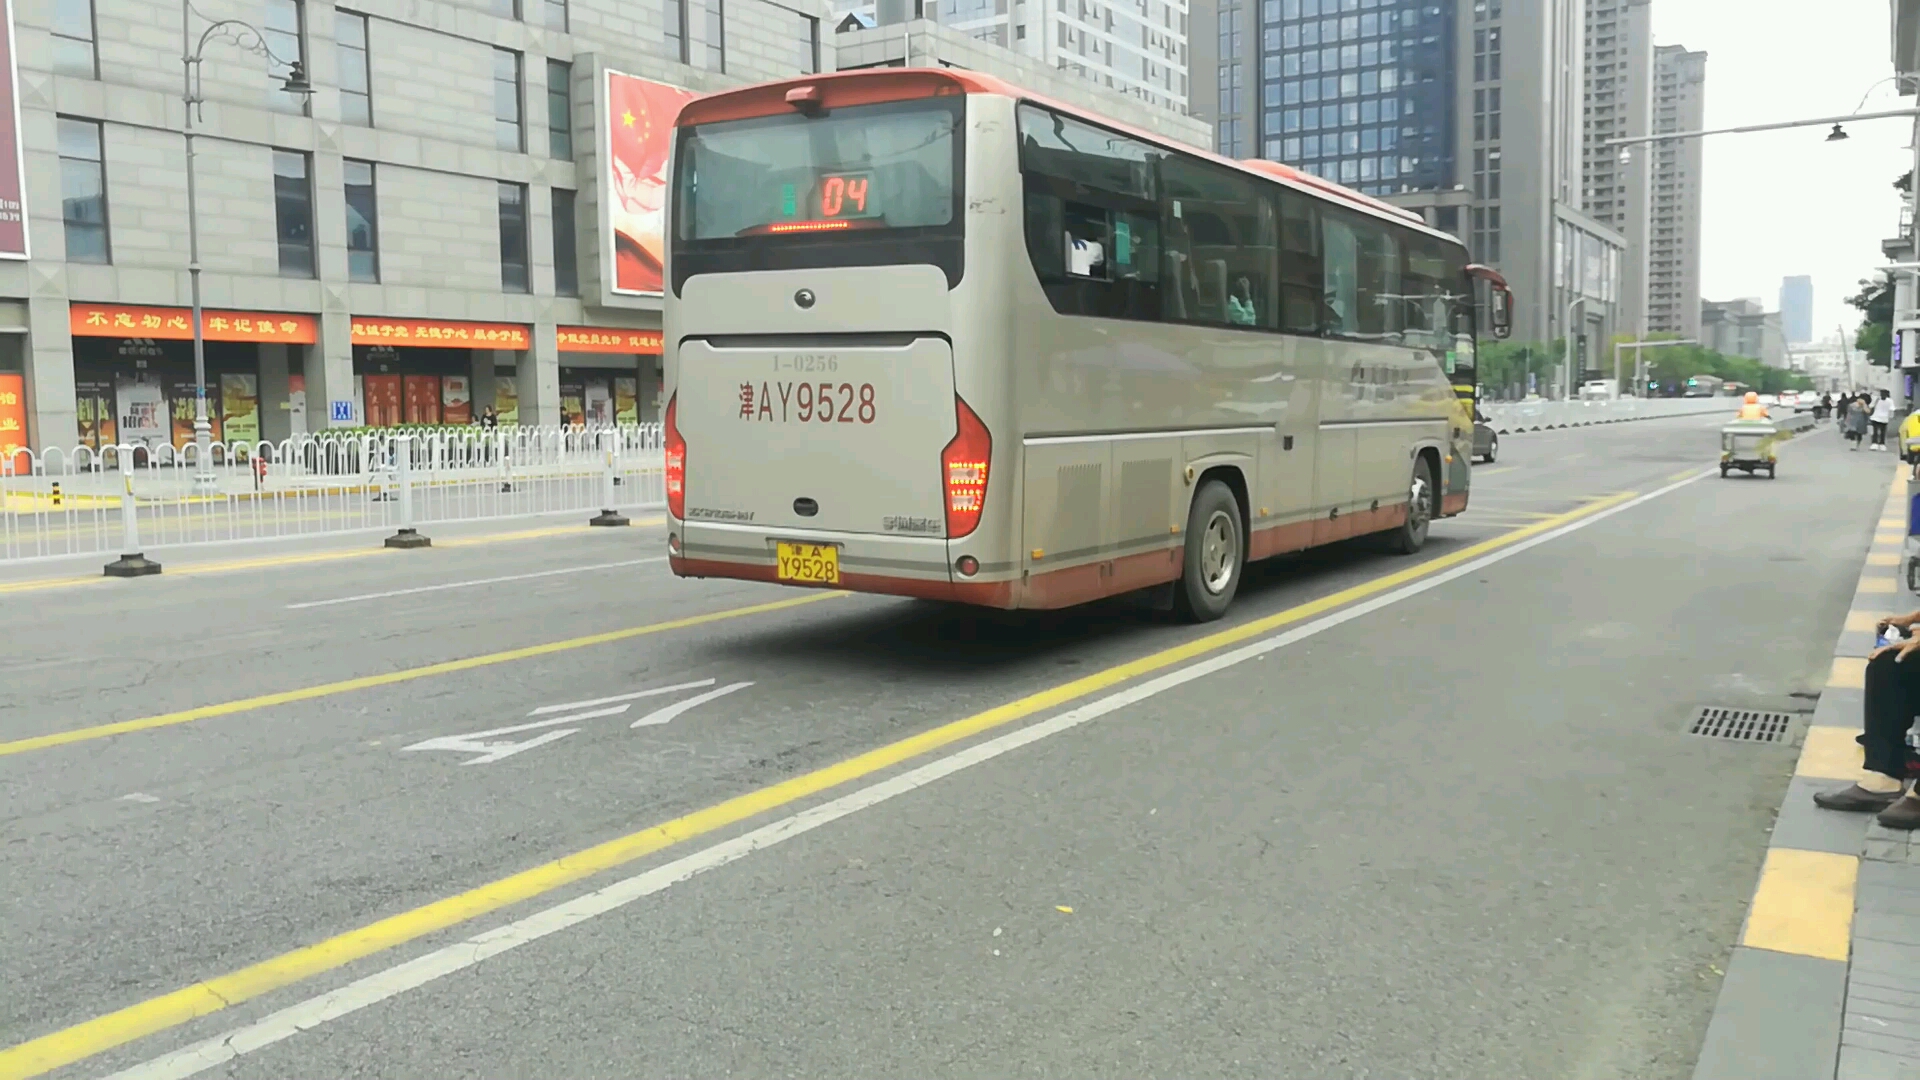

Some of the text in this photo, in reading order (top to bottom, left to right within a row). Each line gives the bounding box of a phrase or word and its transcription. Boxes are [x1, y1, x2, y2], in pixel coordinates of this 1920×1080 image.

[823, 177, 868, 216] 04
[86, 311, 299, 334] 不忘初心 牢记使命
[739, 380, 876, 424] 津AY9528
[780, 556, 836, 581] Y9528
